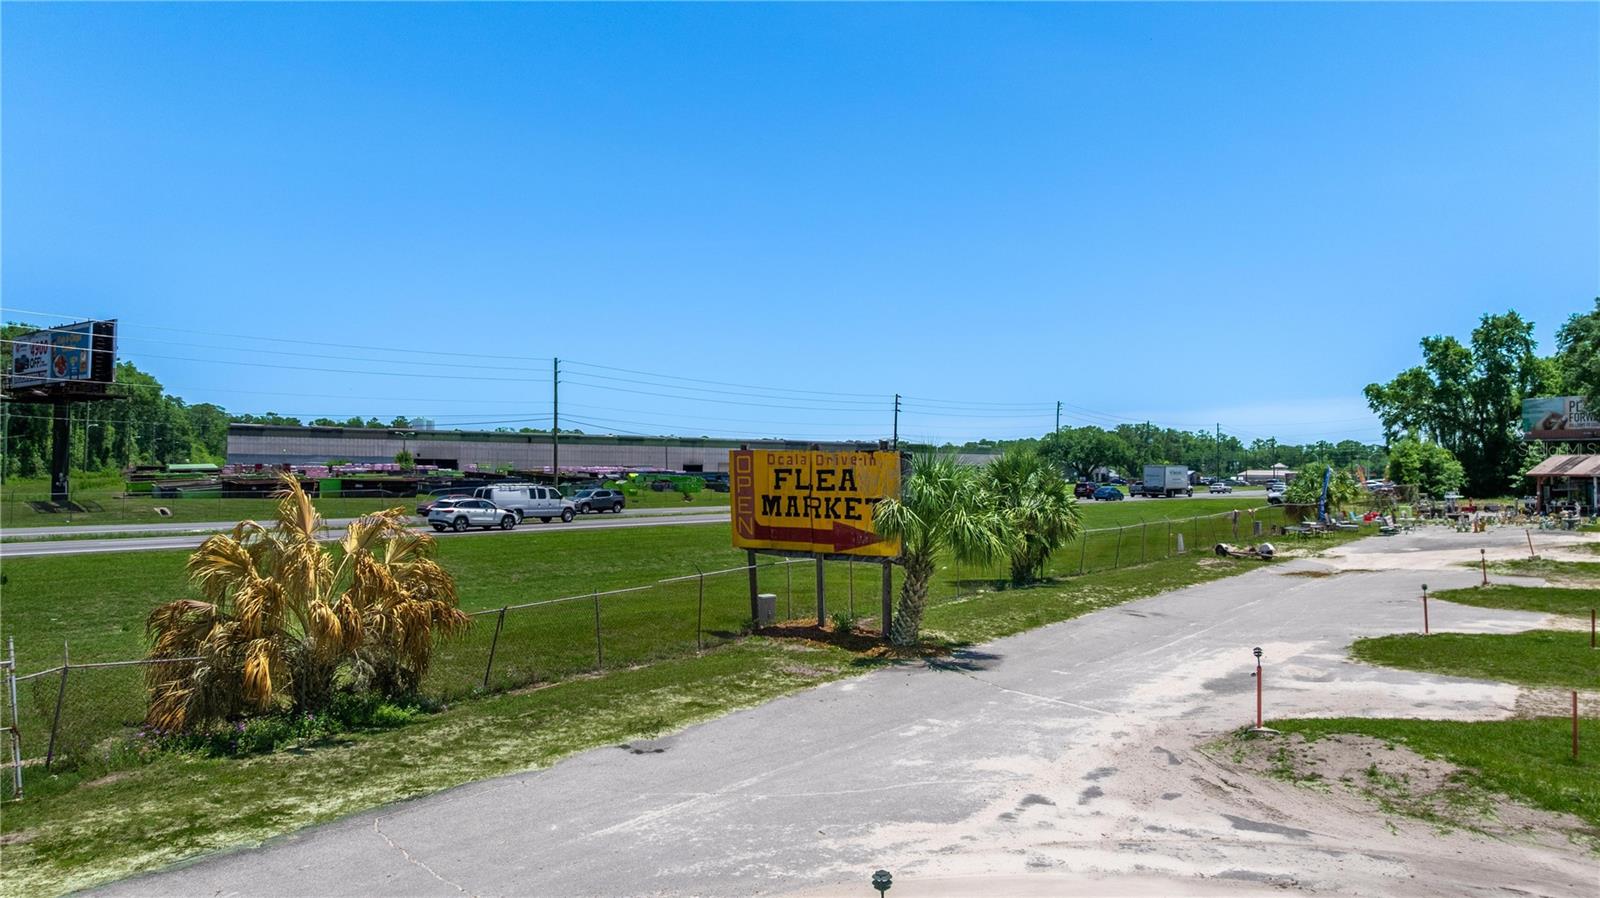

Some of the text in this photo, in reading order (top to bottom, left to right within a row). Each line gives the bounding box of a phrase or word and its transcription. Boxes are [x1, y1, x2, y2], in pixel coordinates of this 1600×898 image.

[767, 453, 807, 466] Ocala
[774, 468, 858, 491] FLEA
[736, 455, 753, 536] OPEN
[761, 494, 883, 521] MARKET
